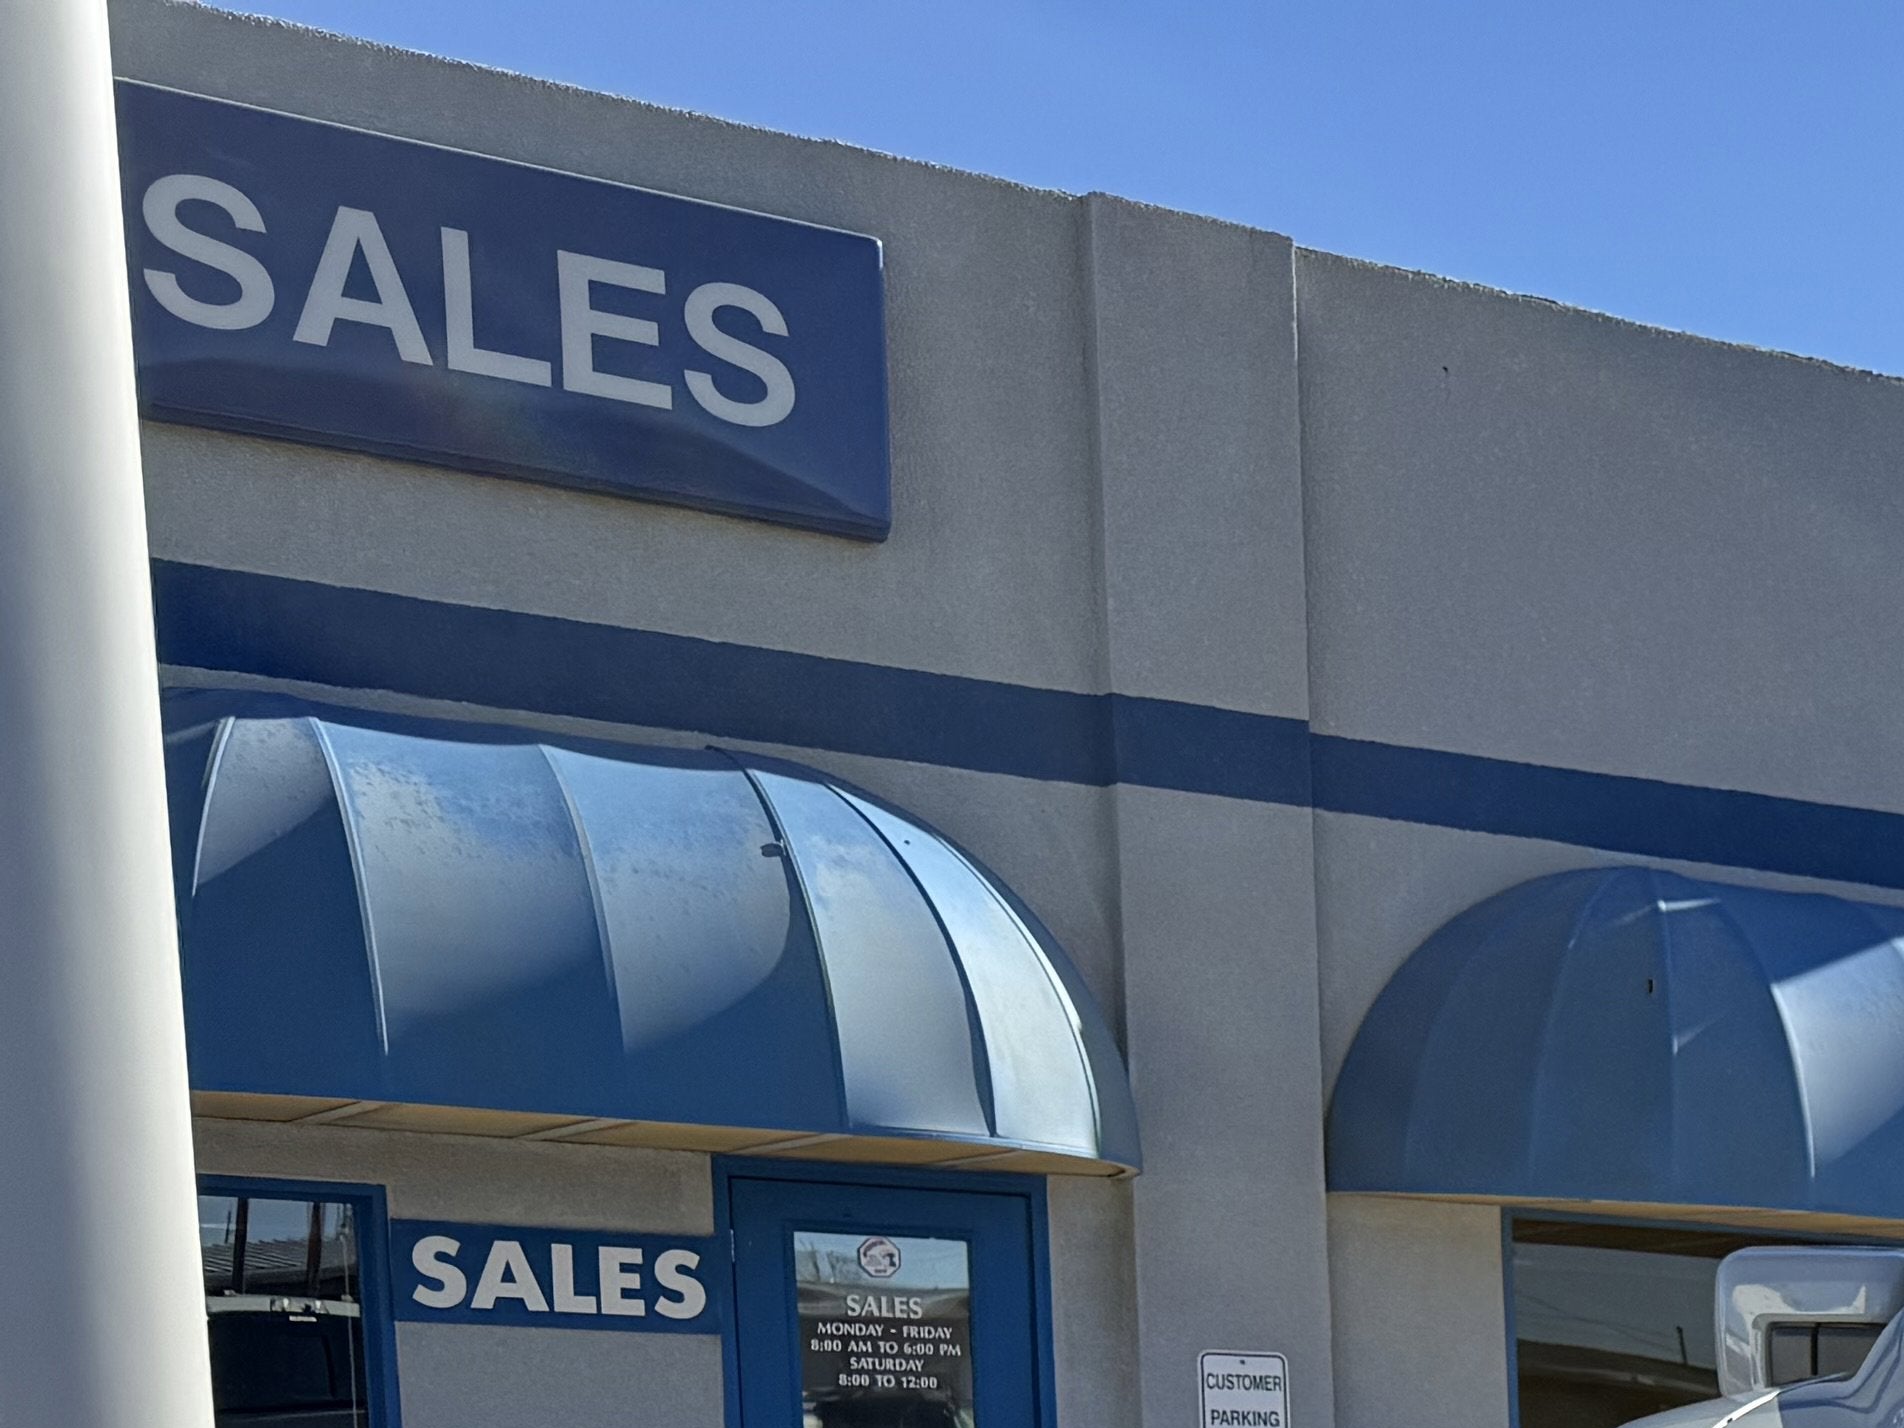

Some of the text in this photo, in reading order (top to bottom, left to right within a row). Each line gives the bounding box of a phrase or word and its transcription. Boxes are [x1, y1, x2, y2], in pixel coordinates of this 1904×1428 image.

[141, 173, 796, 428] SALES
[410, 1234, 707, 1320] SALES
[846, 1294, 923, 1319] SALES
[817, 1322, 884, 1336] MONDAY
[902, 1325, 952, 1339] FRIDAY
[810, 1339, 961, 1356] 8:00 AM TO 6:00 PM
[850, 1357, 924, 1372] SATURDAY
[838, 1373, 937, 1389] 8:00 TO 12:00
[1206, 1373, 1282, 1391] CUSTOMER
[1210, 1409, 1280, 1427] PARKING
